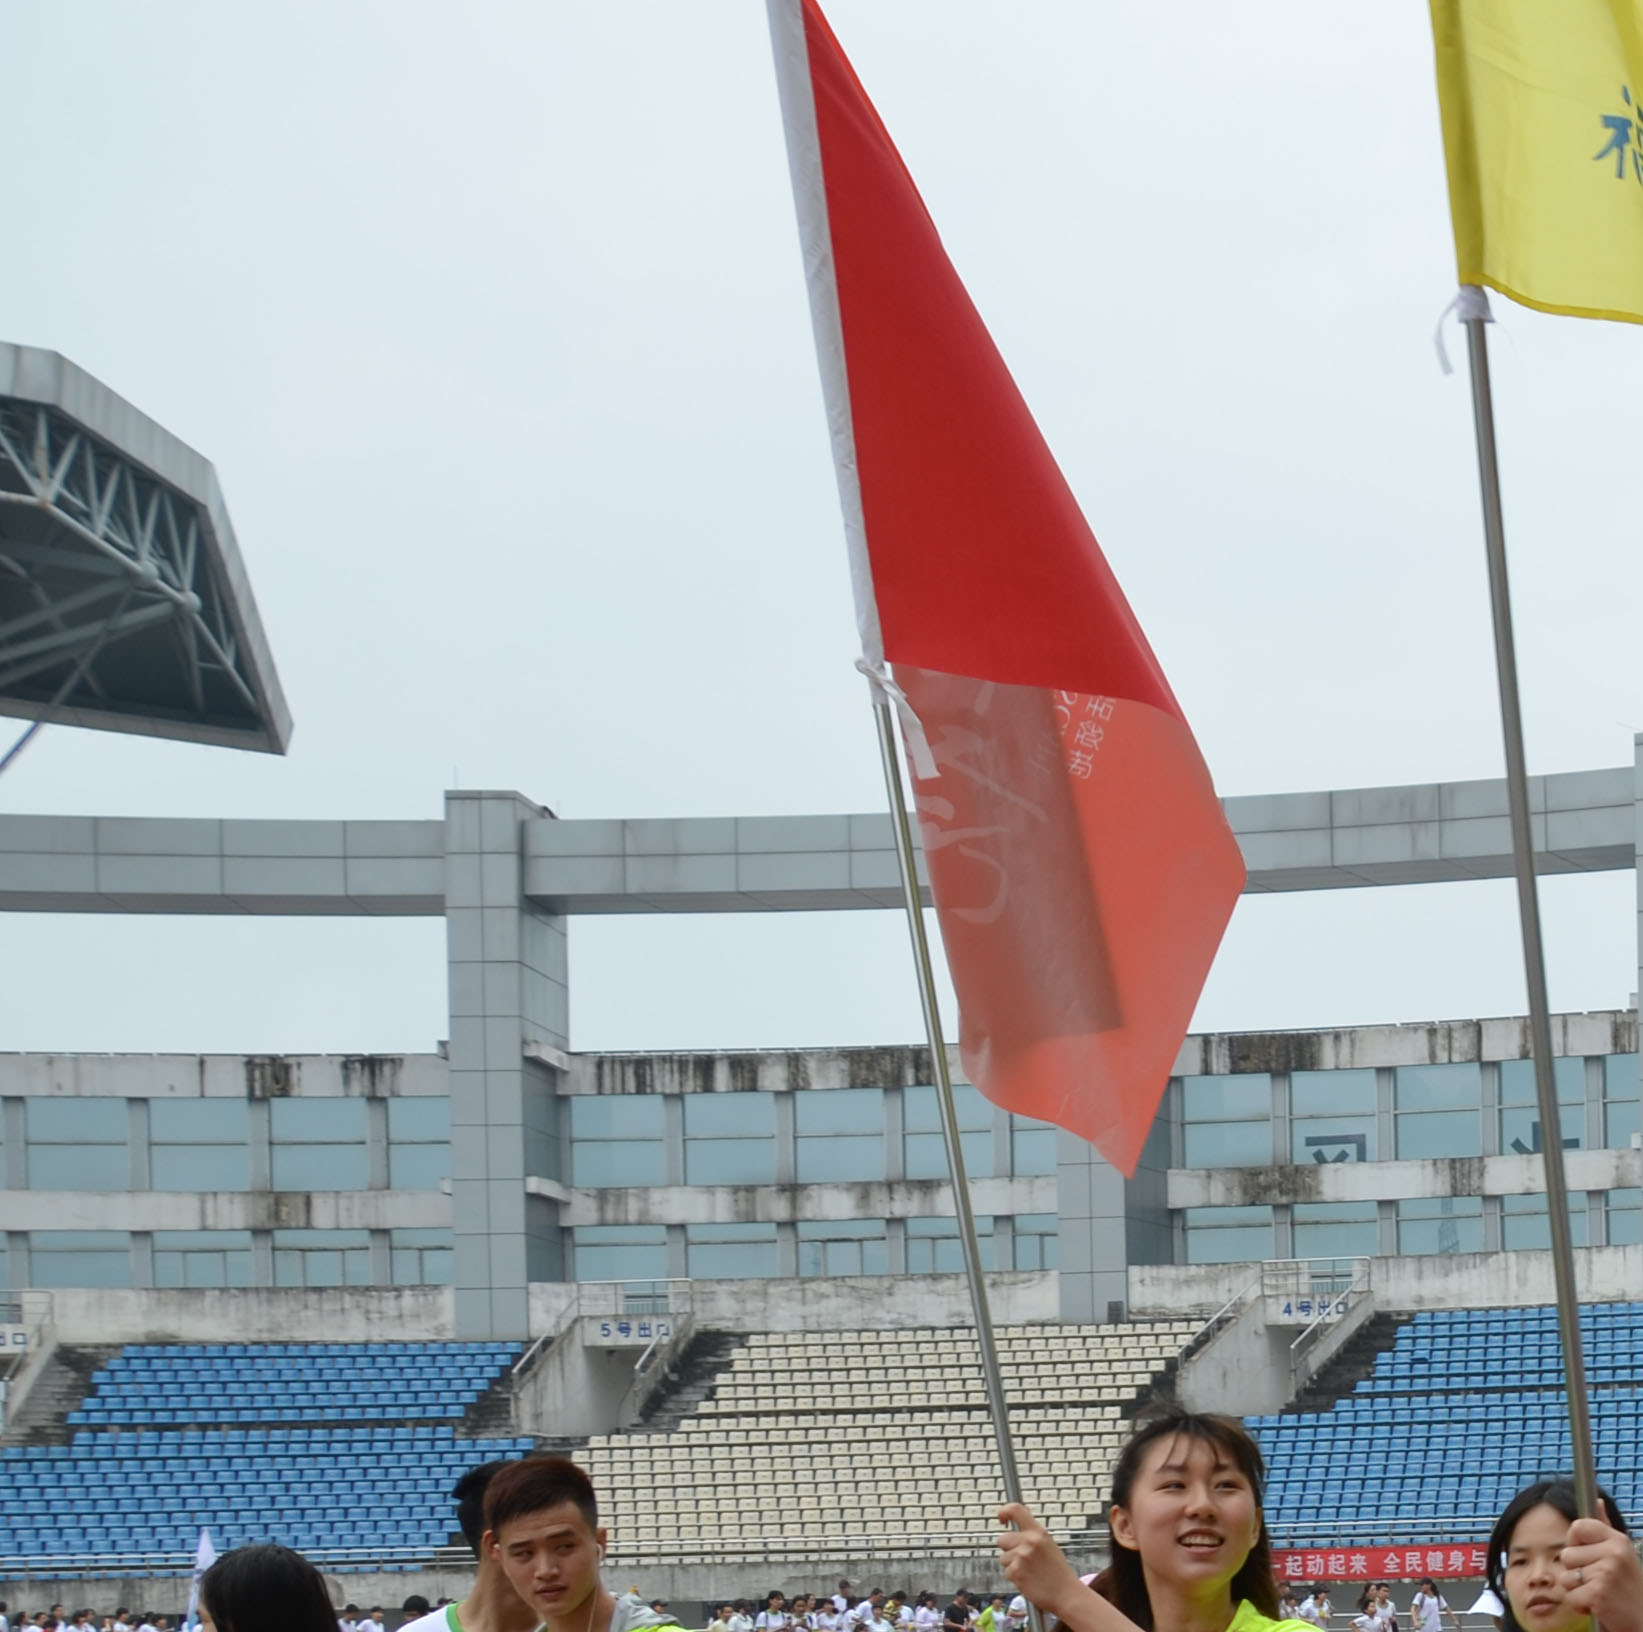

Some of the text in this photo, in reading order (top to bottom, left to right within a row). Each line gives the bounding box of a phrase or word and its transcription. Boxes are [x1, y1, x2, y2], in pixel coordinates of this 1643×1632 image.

[600, 1321, 670, 1339] 5号出口
[1383, 1549, 1488, 1574] 全民健身与
